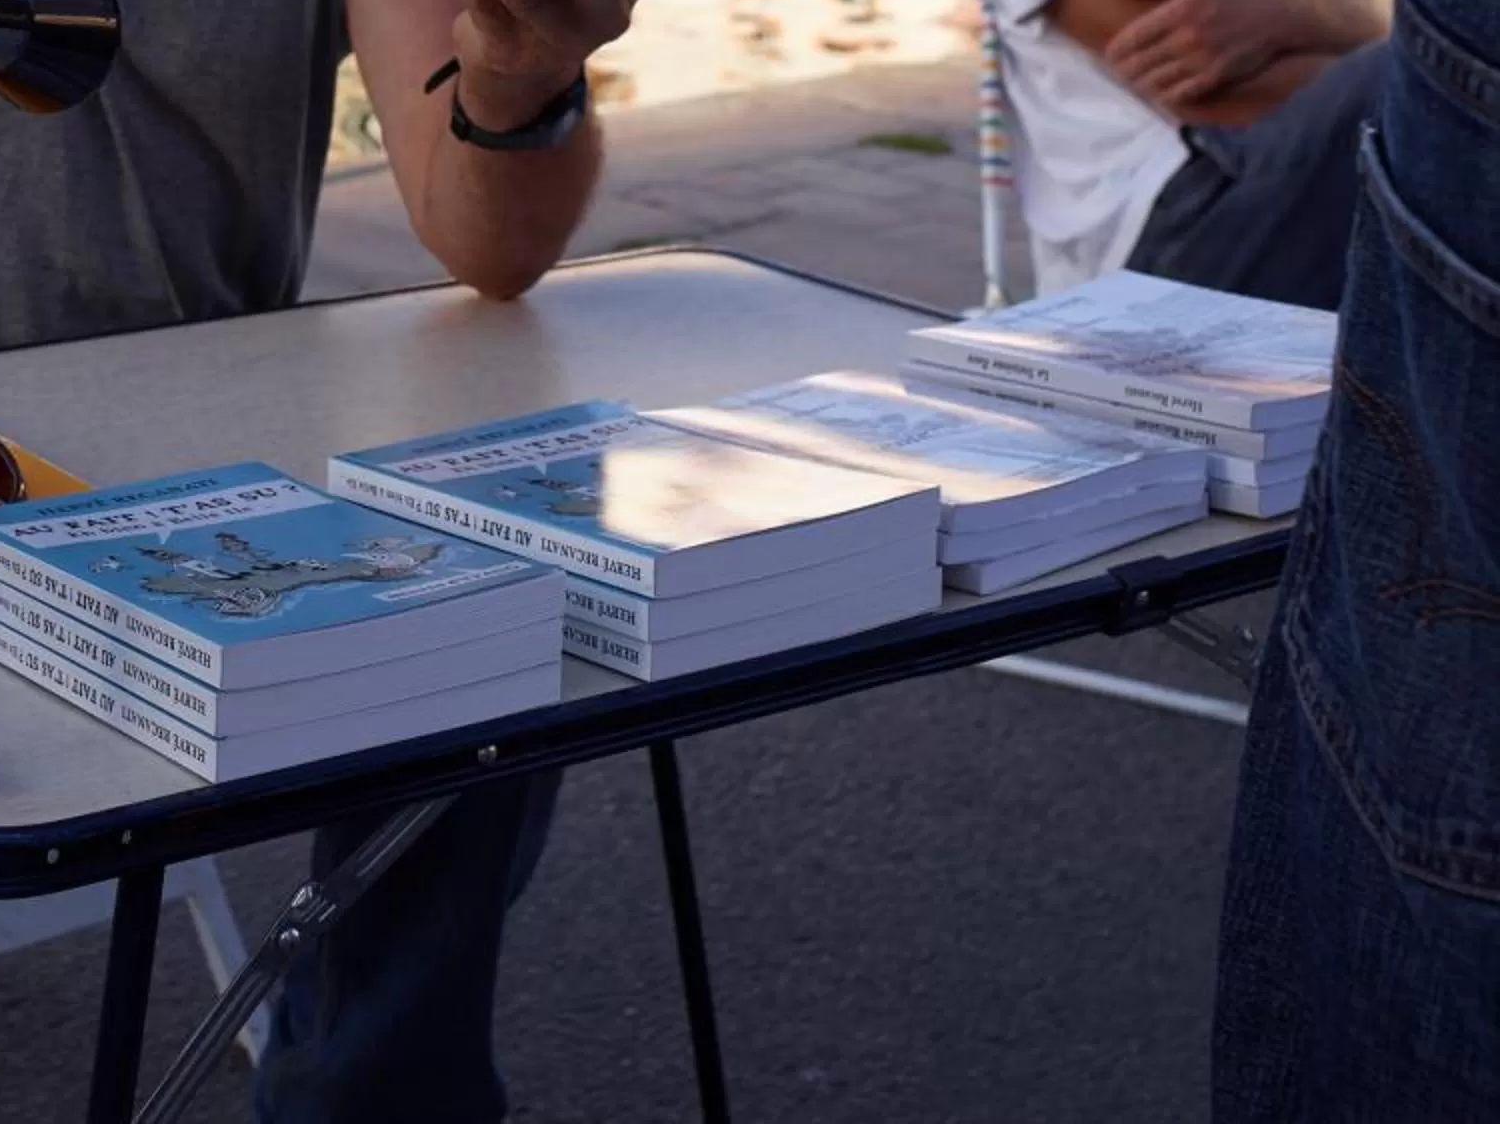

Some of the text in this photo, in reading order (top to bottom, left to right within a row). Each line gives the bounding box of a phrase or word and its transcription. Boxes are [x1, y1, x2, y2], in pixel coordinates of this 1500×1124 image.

[425, 500, 440, 518] SU
[481, 519, 511, 541] FAIT
[515, 527, 533, 547] AU
[540, 537, 599, 567] RECANATI
[76, 591, 101, 618] FAIT
[103, 604, 120, 625] AU
[126, 613, 175, 651] RECANATI
[101, 648, 116, 668] AU
[99, 696, 115, 714] AU
